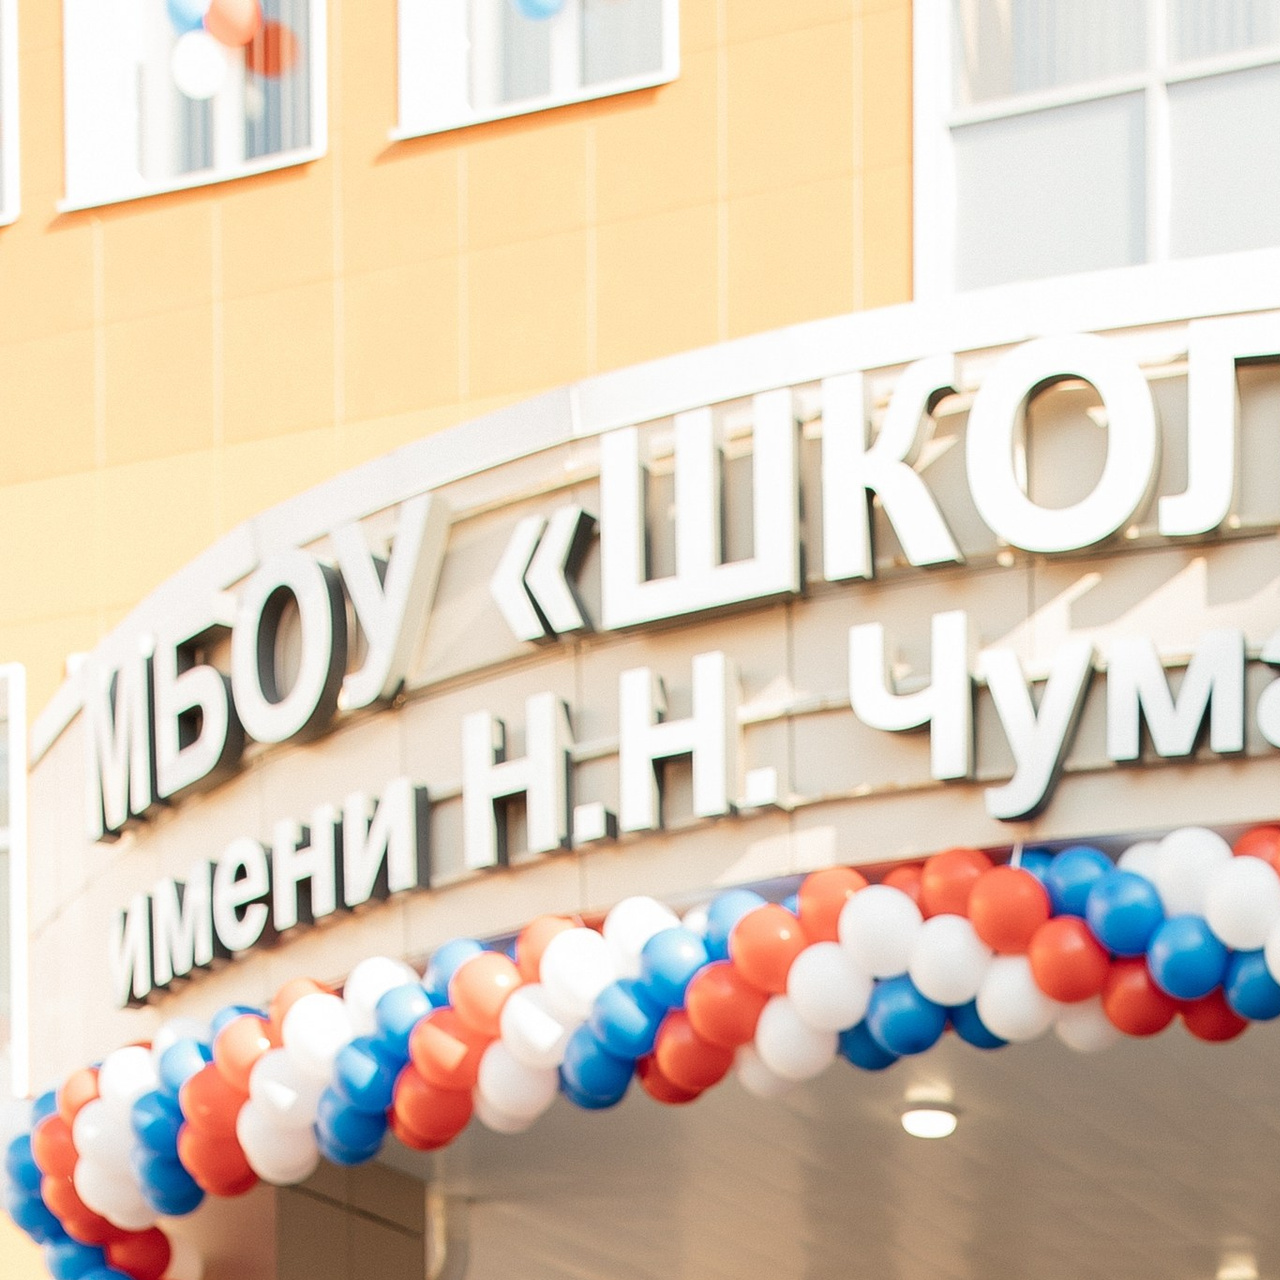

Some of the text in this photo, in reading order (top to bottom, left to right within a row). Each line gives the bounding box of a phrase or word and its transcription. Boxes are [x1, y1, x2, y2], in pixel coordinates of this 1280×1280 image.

[84, 494, 450, 842] МБОУ
[112, 777, 429, 1006] имени
[462, 651, 780, 871] Н.Н.
